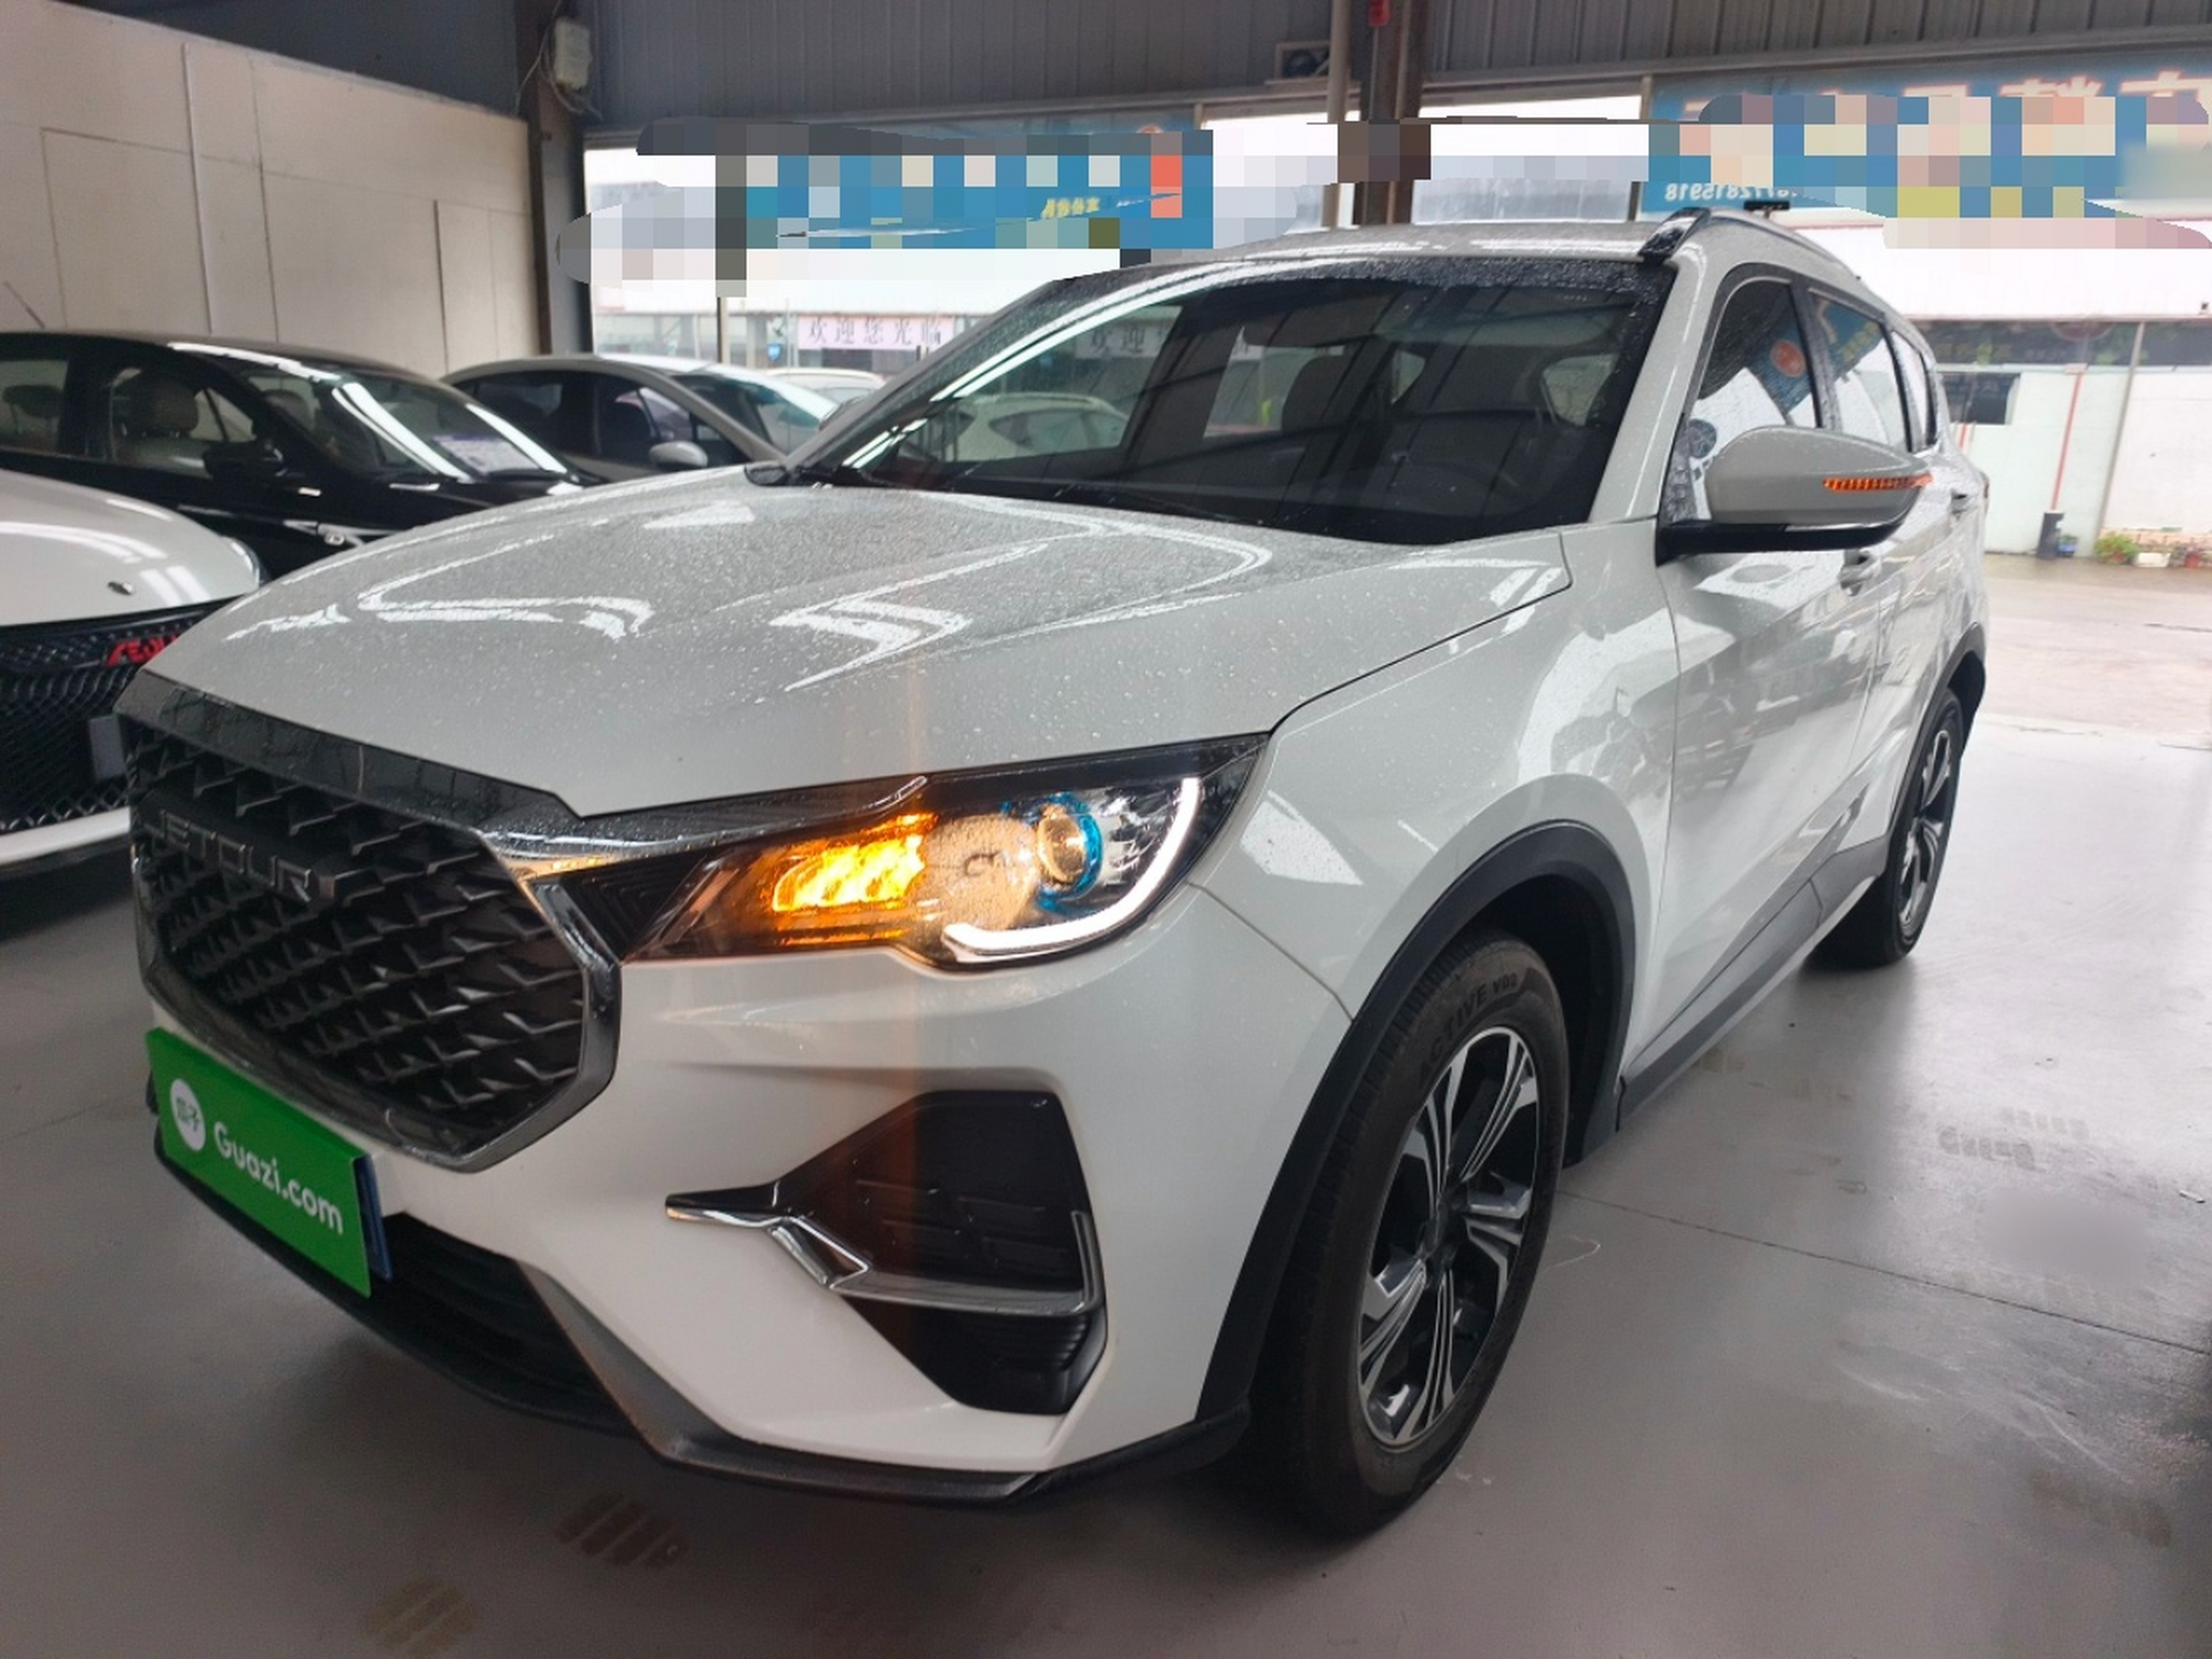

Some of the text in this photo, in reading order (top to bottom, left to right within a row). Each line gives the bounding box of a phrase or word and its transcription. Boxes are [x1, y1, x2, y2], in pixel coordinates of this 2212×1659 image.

[808, 316, 941, 346] 欢迎您光临
[214, 1121, 344, 1235] Guazi.com
